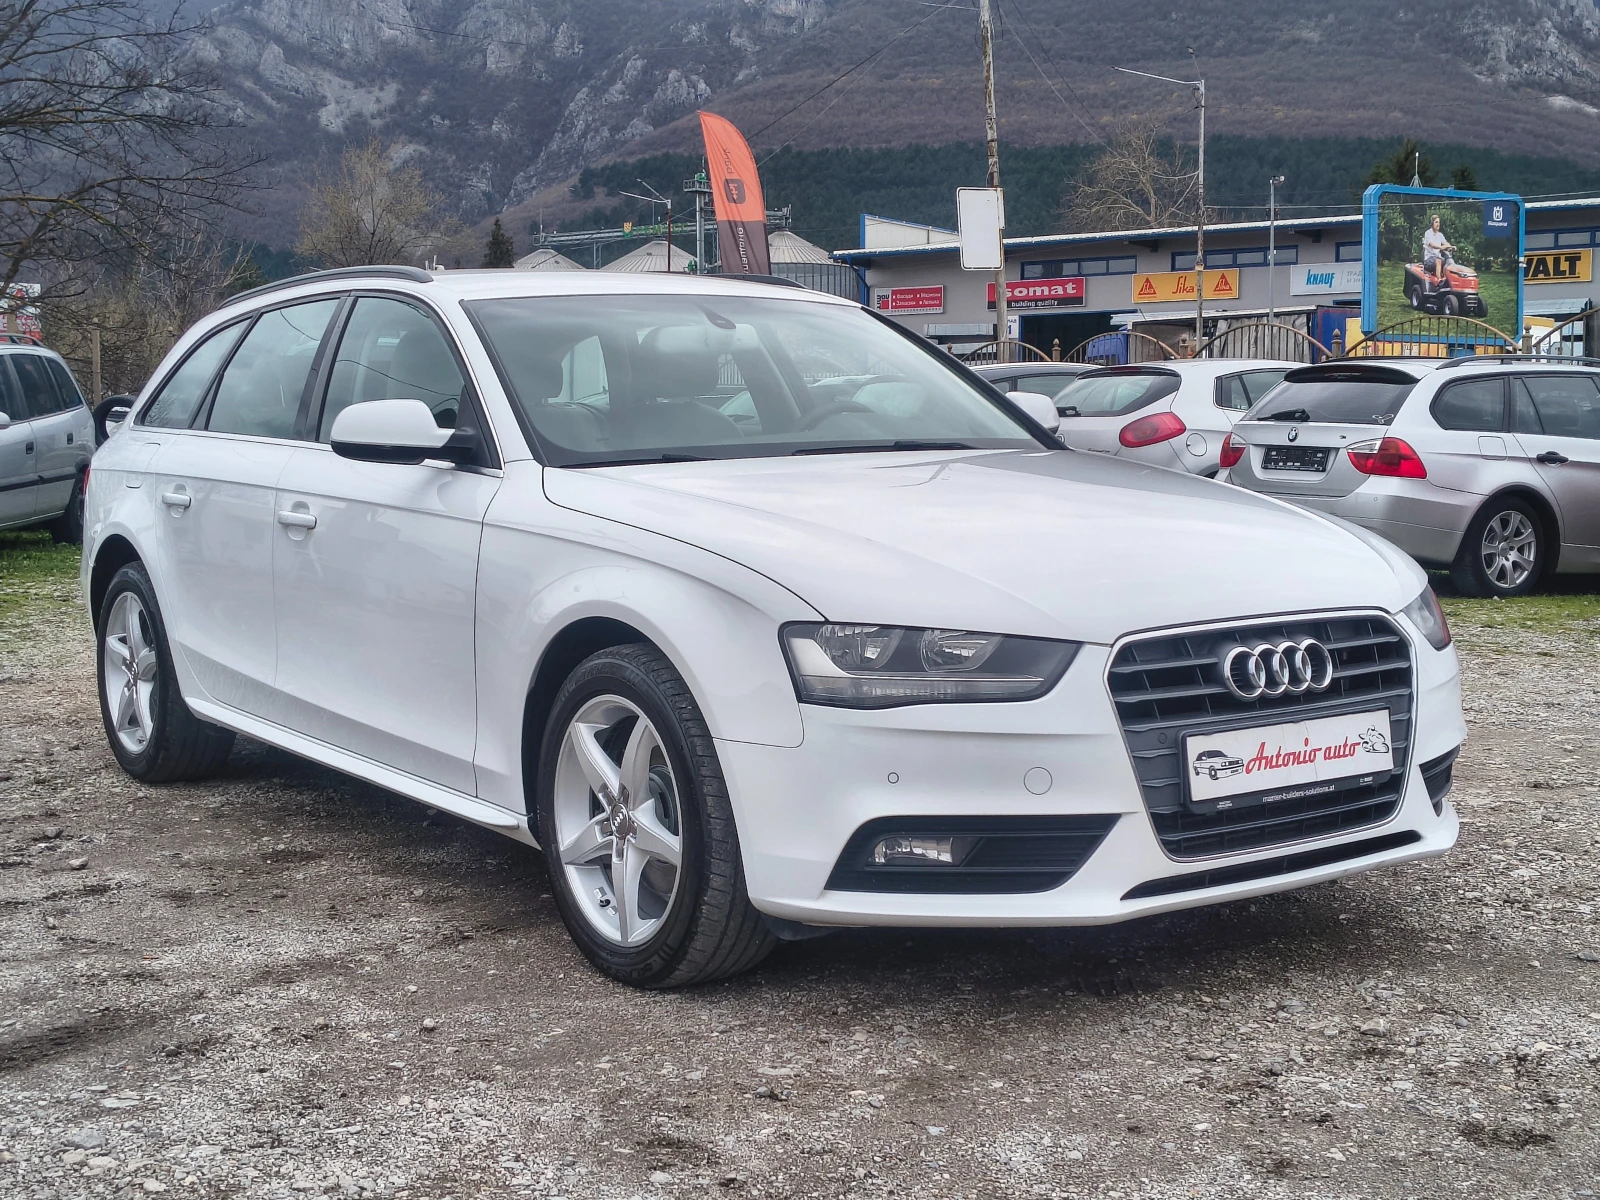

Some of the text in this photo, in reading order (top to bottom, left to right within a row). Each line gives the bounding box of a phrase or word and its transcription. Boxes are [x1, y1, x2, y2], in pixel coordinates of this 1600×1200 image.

[1005, 282, 1077, 298] somat
[1171, 275, 1195, 294] Sika
[1245, 736, 1361, 774] Antonio auto
